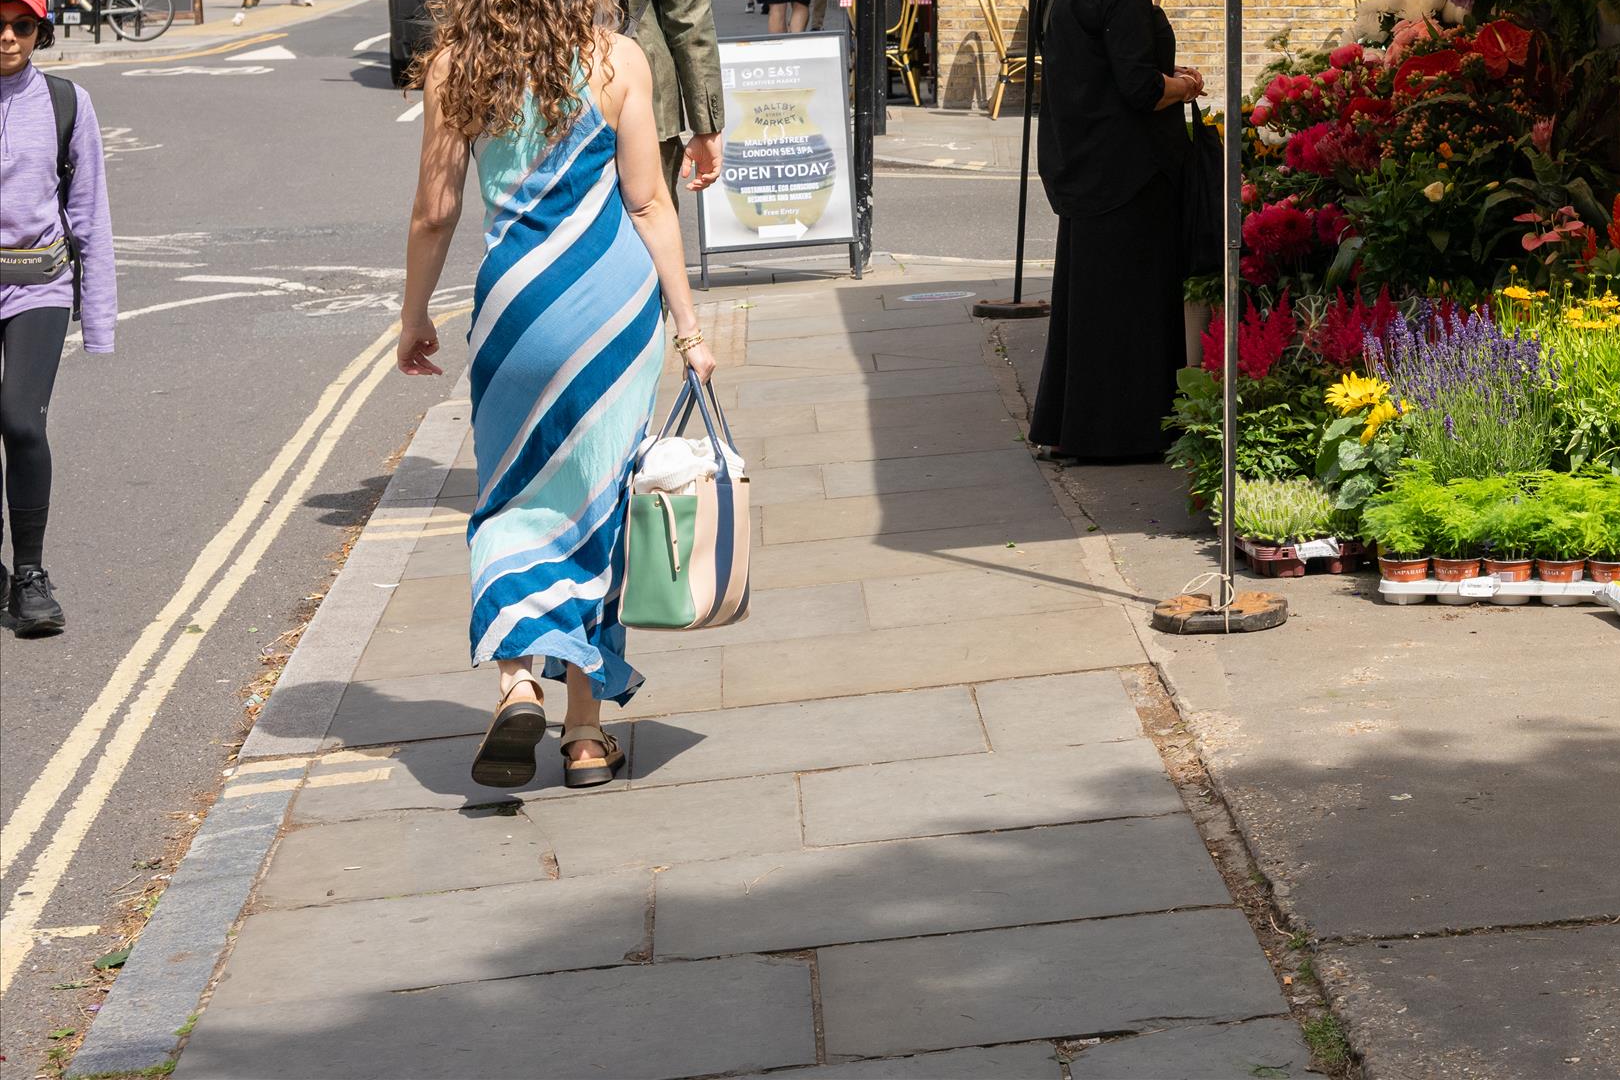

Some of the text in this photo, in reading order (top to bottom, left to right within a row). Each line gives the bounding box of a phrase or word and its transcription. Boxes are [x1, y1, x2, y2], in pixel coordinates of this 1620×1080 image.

[741, 67, 764, 80] GO
[768, 65, 801, 78] EAST
[754, 102, 796, 114] MALTBY
[754, 114, 797, 127] MARKET
[779, 136, 809, 145] STREET
[742, 146, 814, 159] LONDON SE1 3PA
[725, 162, 830, 182] OPEN TODAY
